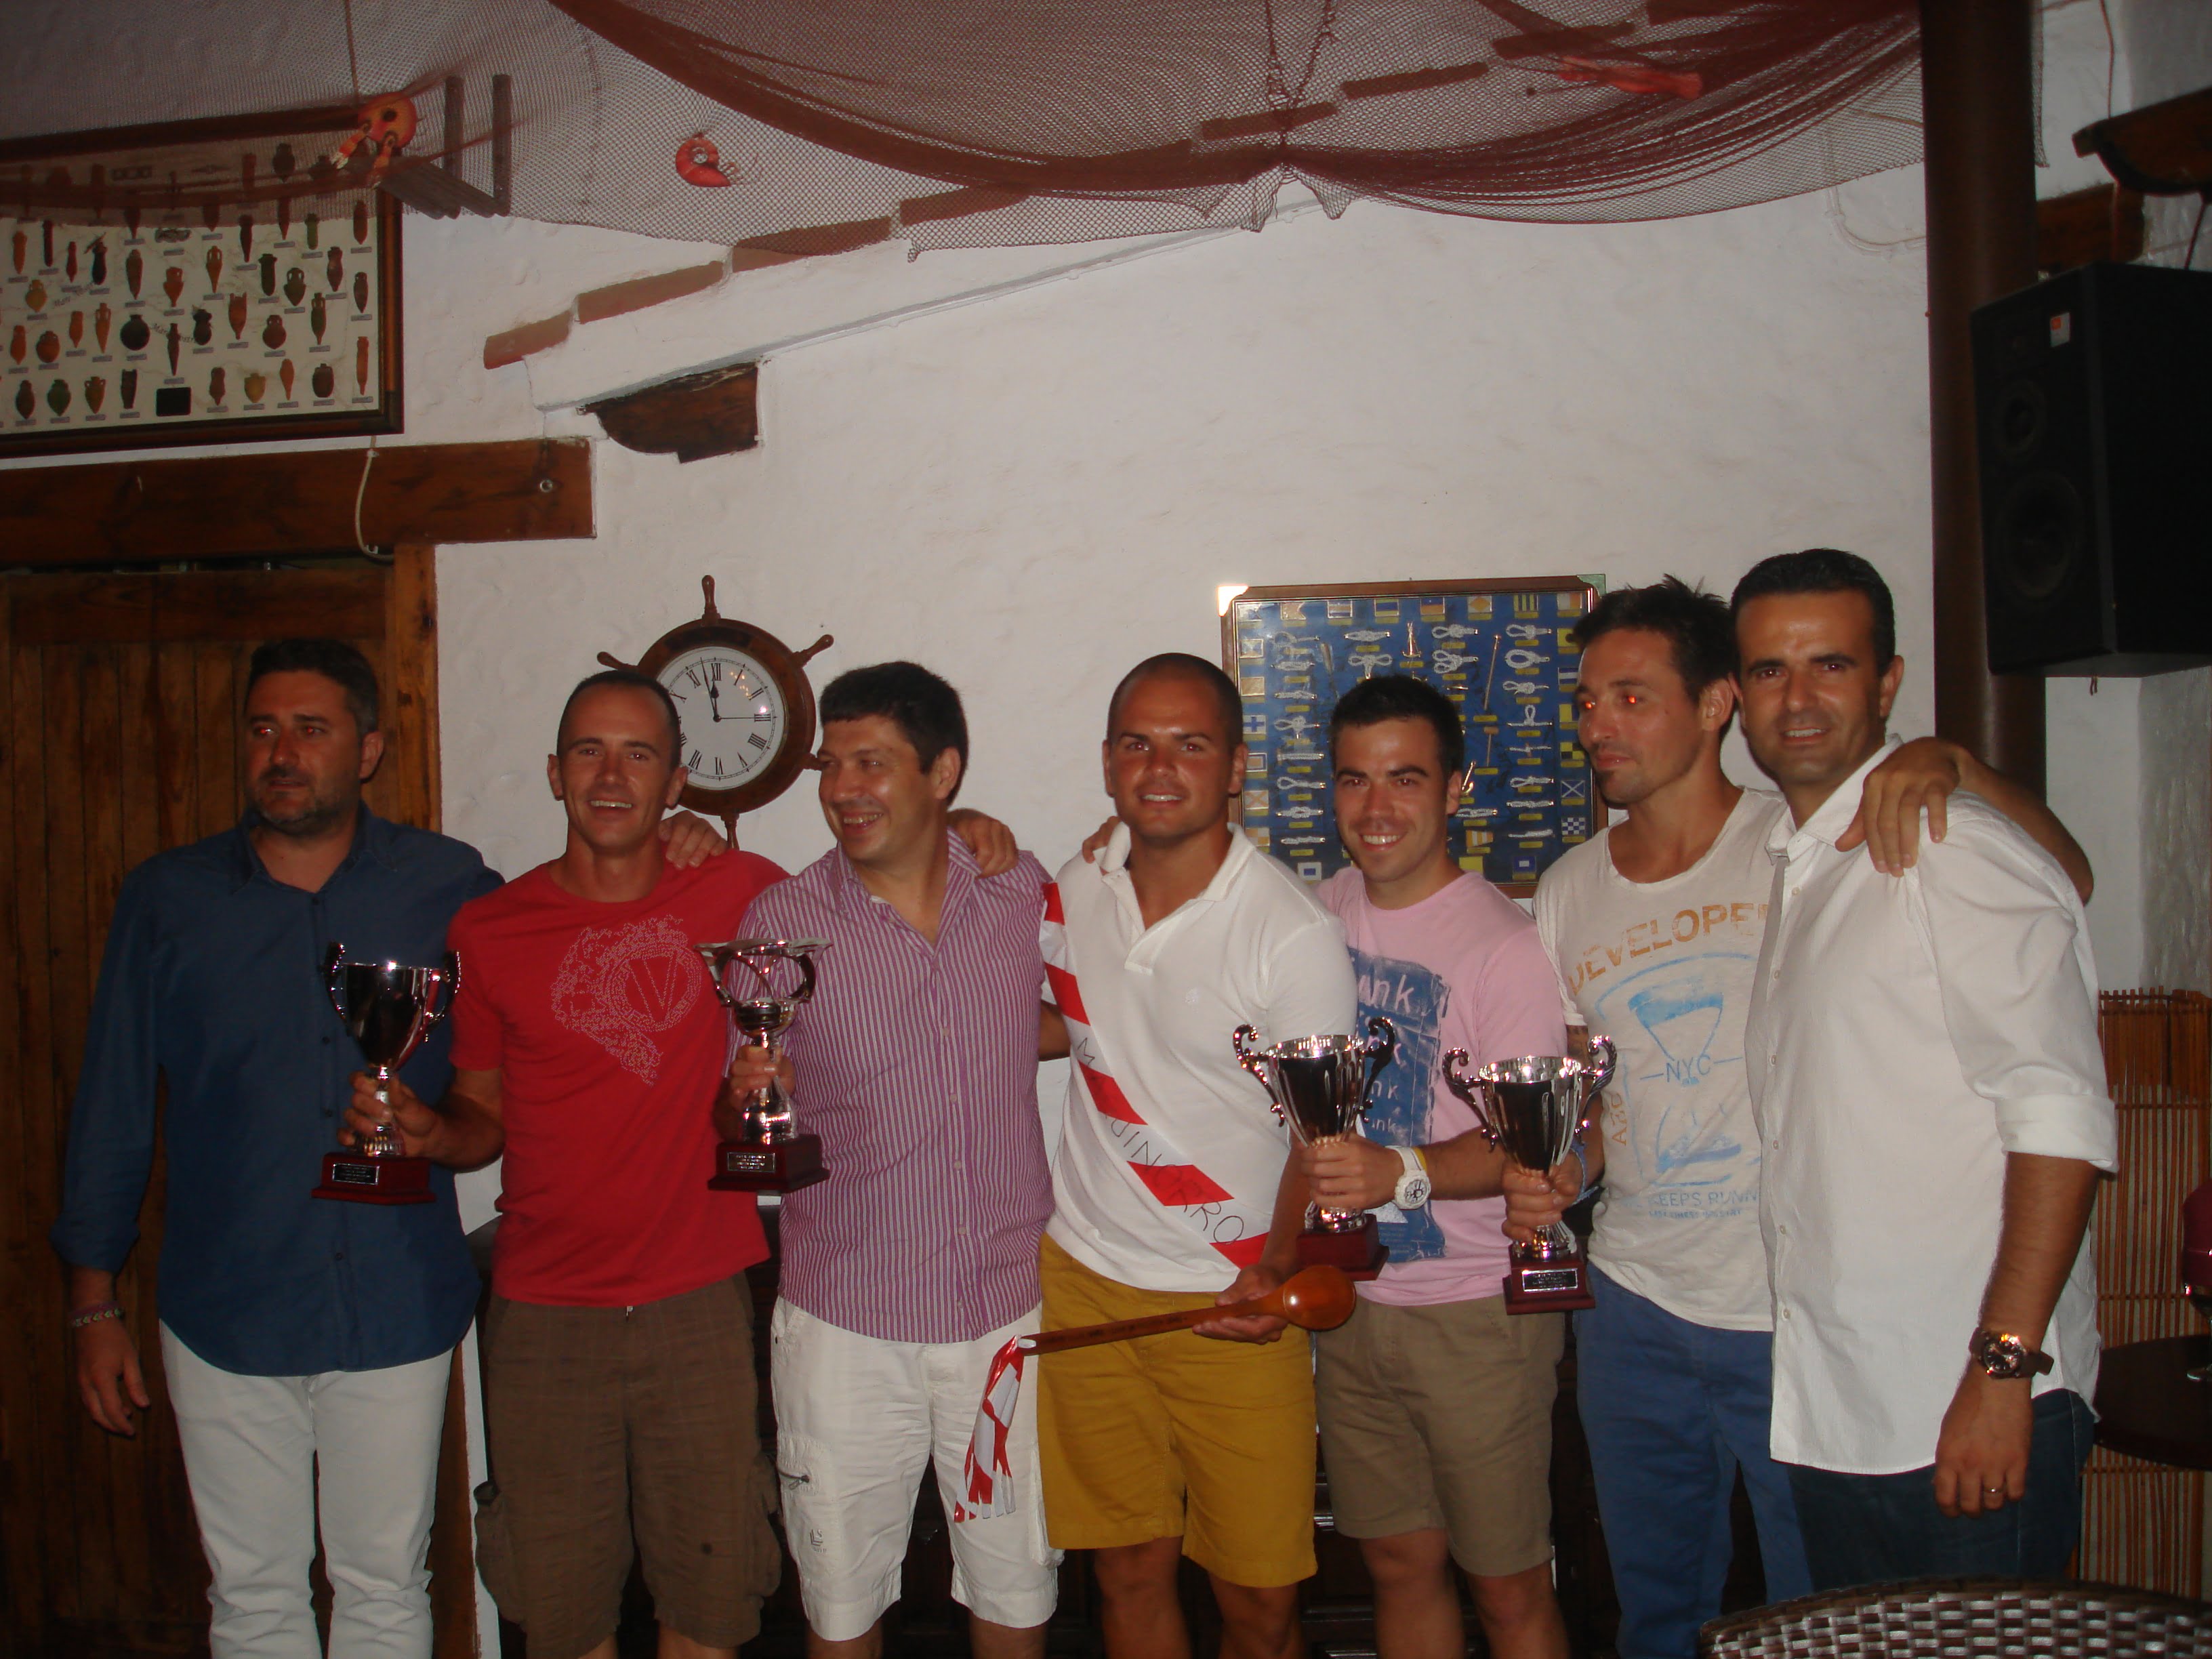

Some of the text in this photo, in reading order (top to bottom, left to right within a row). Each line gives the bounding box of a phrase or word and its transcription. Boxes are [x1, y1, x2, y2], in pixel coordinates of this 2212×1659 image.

[711, 663, 722, 682] XII
[754, 713, 771, 722] III
[1666, 1055, 1711, 1082] NYC
[1650, 1191, 1702, 1207] EEPS
